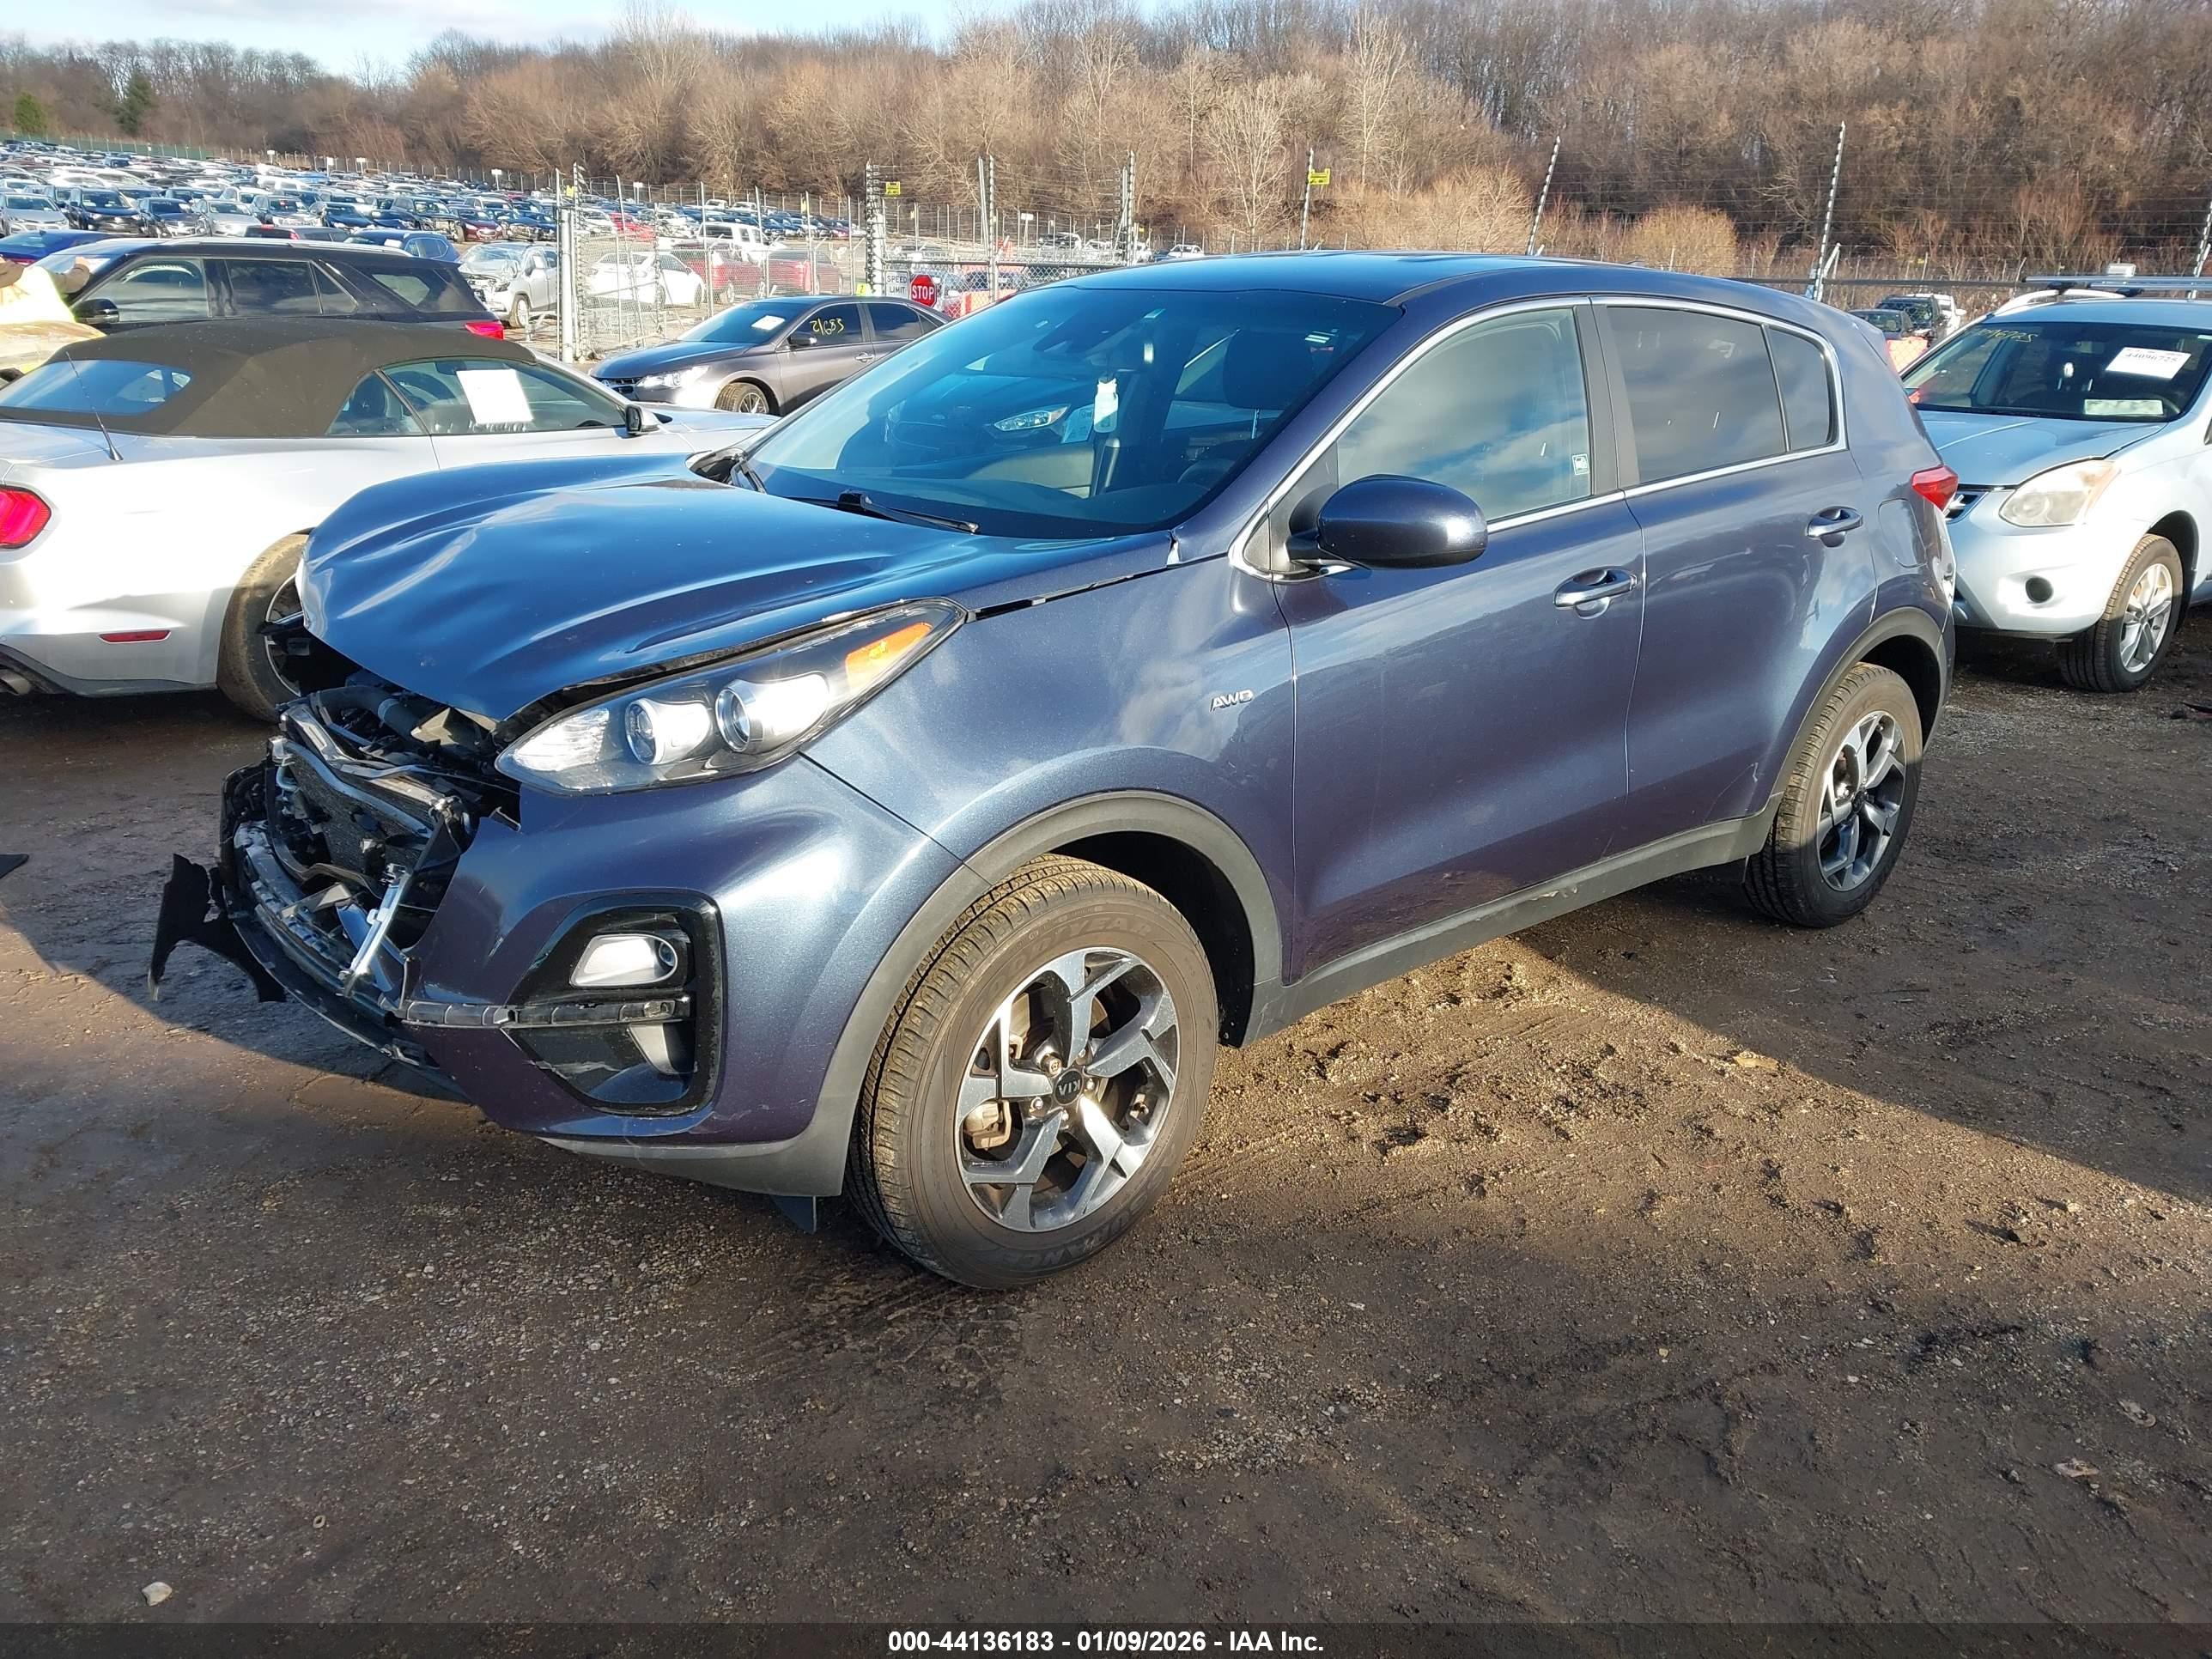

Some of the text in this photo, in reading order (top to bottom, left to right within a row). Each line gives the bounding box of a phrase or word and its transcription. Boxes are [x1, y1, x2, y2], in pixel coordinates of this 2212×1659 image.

[887, 275, 908, 283] SPEED
[912, 284, 934, 301] STOP
[1210, 690, 1254, 712] AWD
